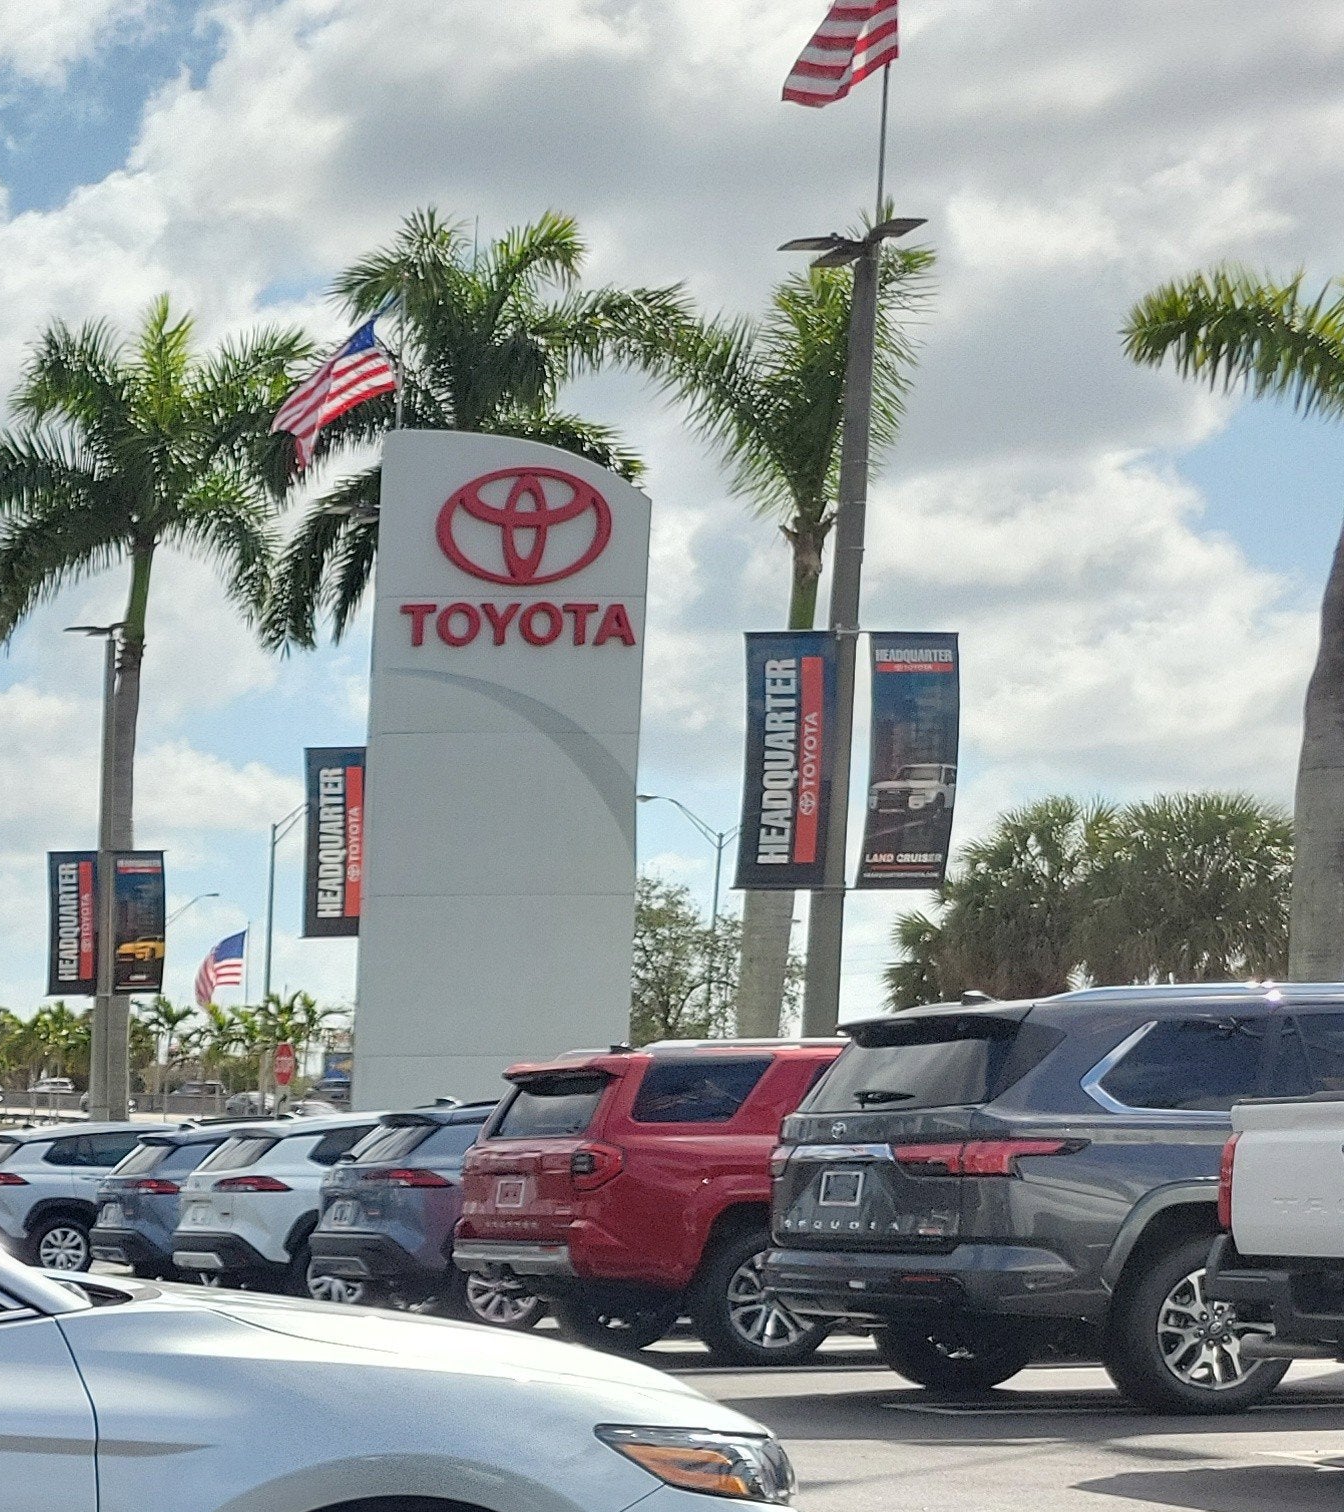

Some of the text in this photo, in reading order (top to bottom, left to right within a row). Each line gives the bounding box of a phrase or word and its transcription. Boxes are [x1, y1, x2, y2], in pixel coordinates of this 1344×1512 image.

[399, 601, 636, 647] TOYOTA
[756, 658, 799, 865] HEADQUARTER
[801, 711, 820, 791] TOYOTA
[316, 767, 346, 918] HEADQUARTER
[348, 806, 361, 863] TOYOTA
[865, 853, 943, 863] LAND CRUISER
[58, 863, 80, 981] HEADQUARTER
[784, 1219, 900, 1231] SEQUOIA
